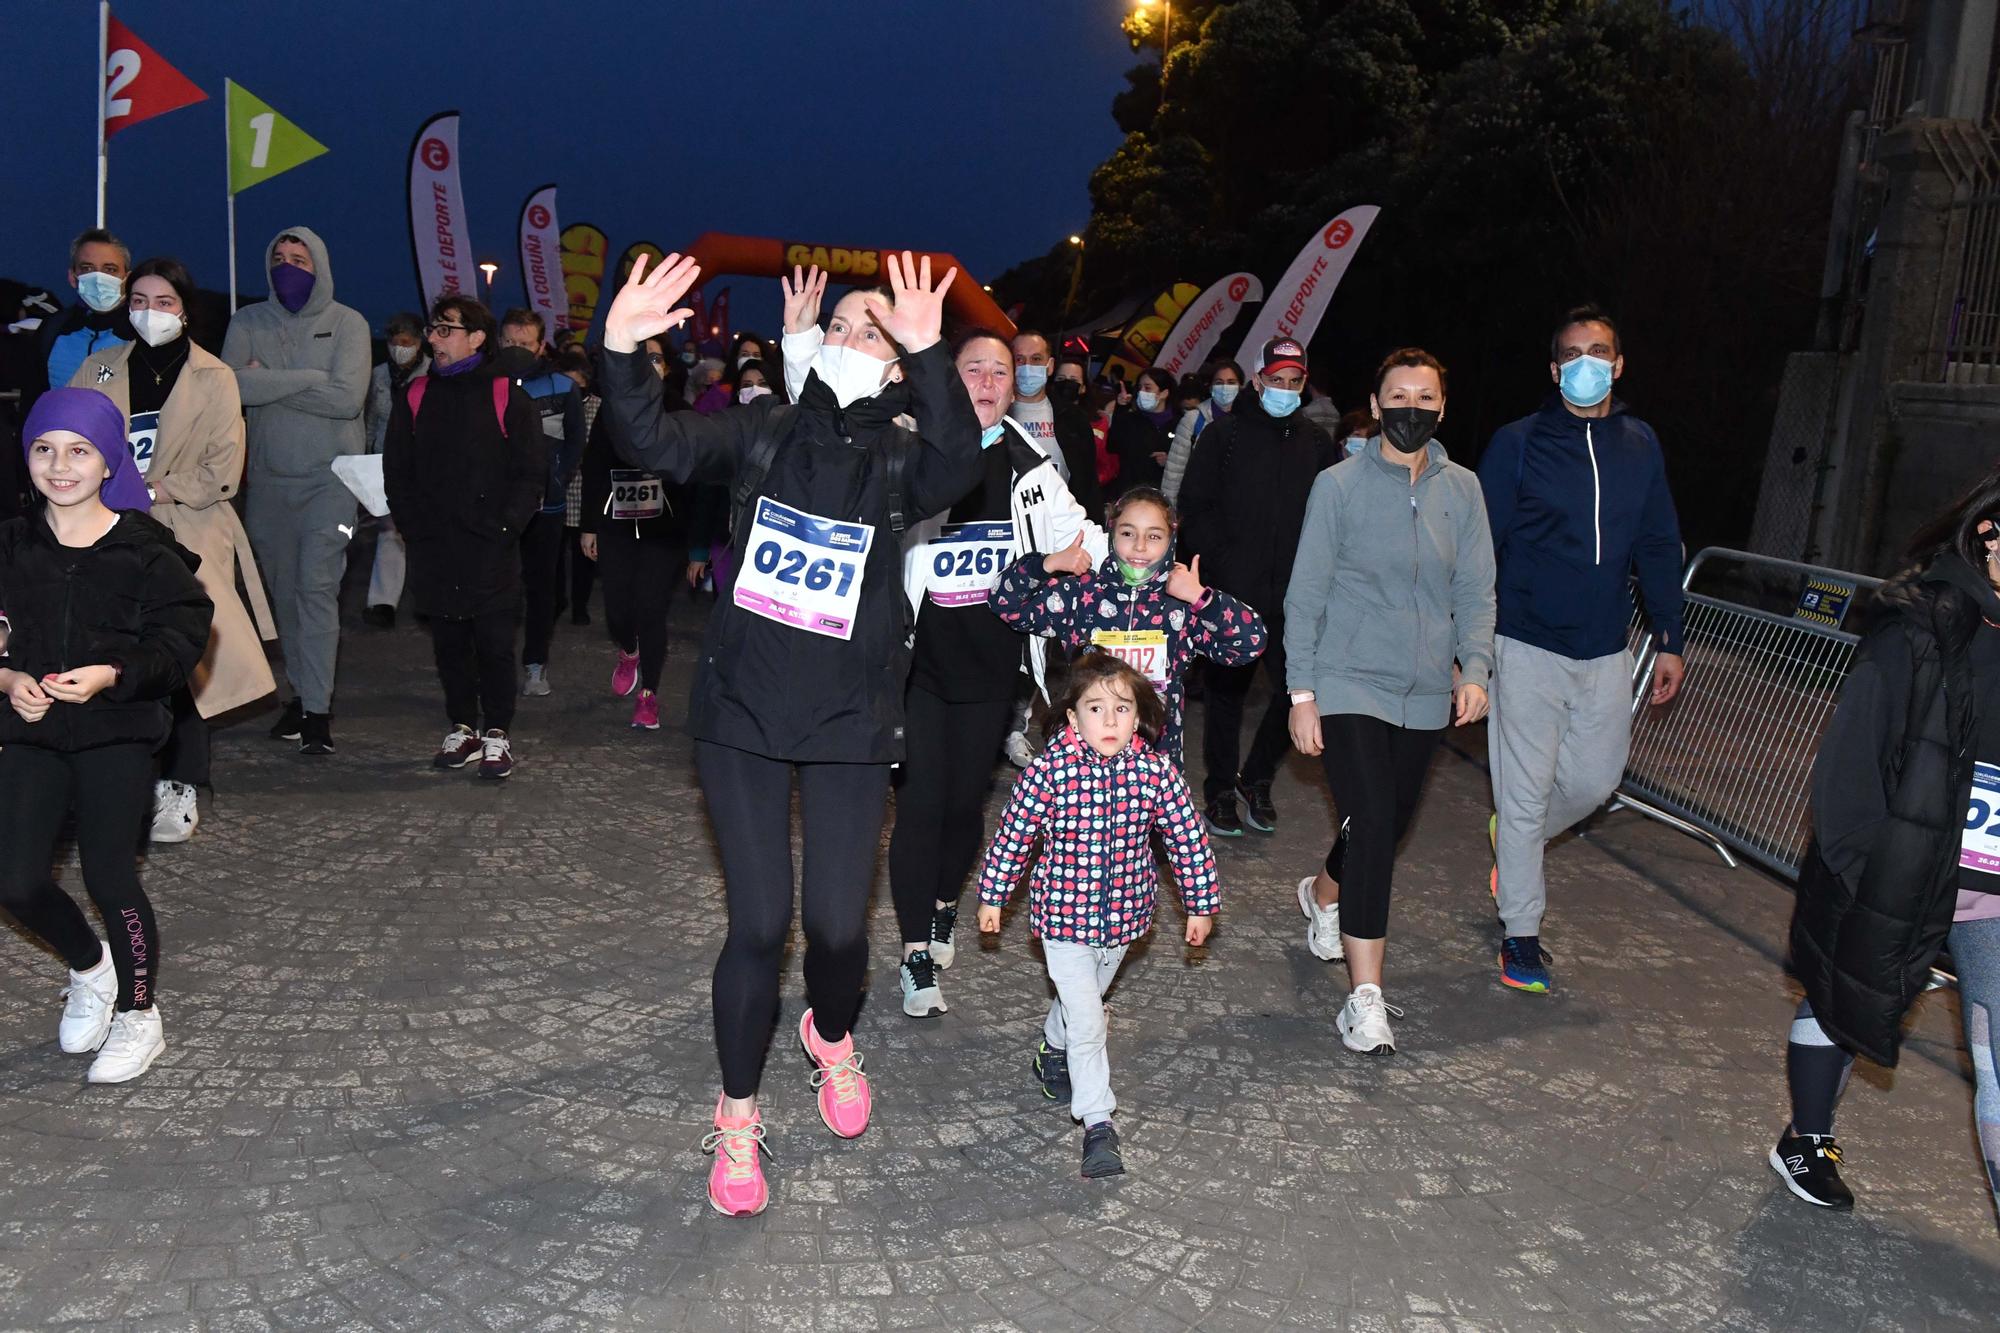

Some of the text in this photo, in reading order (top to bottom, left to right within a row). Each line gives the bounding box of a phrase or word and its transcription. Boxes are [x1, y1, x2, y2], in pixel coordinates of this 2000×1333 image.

[105, 48, 142, 121] 2
[249, 112, 275, 168] 1
[432, 181, 456, 258] DEPORTE
[527, 234, 550, 295] CORUÑA
[786, 244, 879, 276] GADIS
[1284, 255, 1329, 330] DEPORTE
[1183, 297, 1226, 349] DEPORTE
[615, 484, 659, 502] 0261
[1020, 484, 1045, 509] HH
[754, 540, 856, 597] 0261
[933, 547, 1009, 578] 0261
[120, 907, 148, 966] WORKOUT
